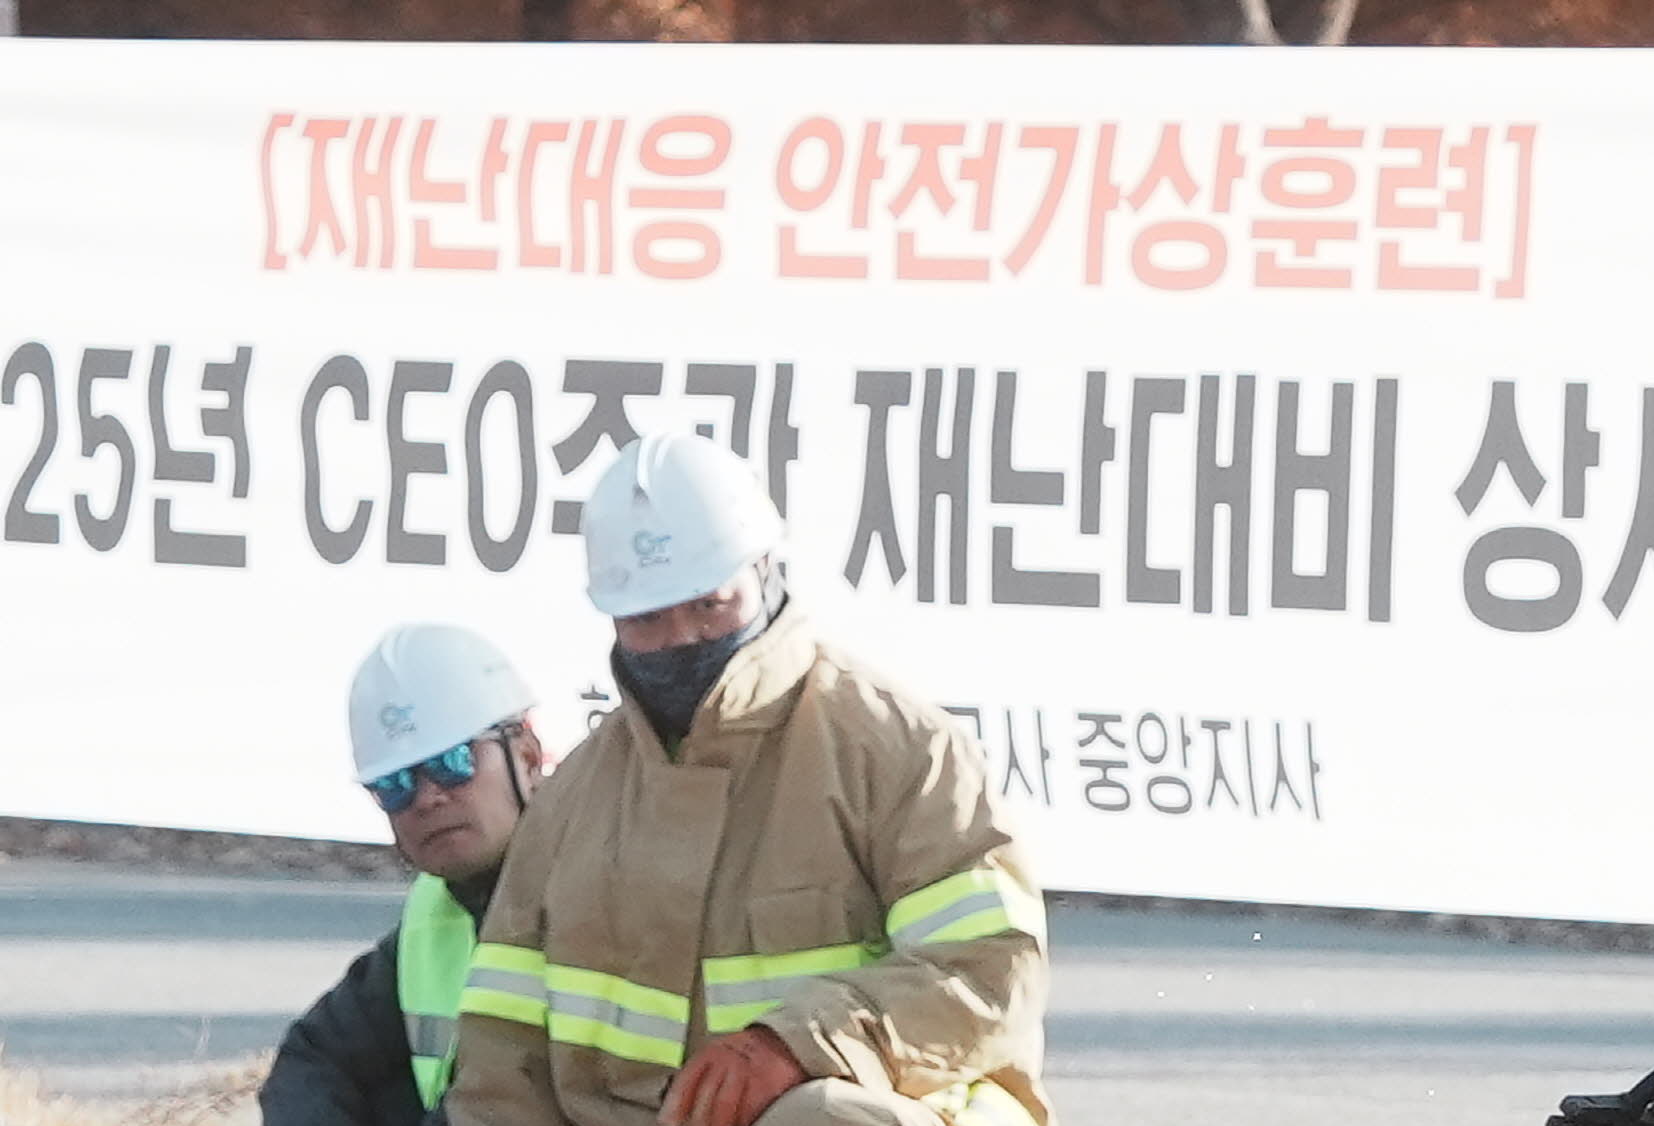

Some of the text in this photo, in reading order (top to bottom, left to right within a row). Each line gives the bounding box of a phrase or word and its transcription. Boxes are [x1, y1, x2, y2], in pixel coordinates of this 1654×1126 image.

[260, 112, 1536, 299] [재난대응 안전가상훈련]
[1, 342, 252, 568] 25년
[844, 368, 1398, 622] 재난대비
[1078, 712, 1320, 819] 중앙지사
